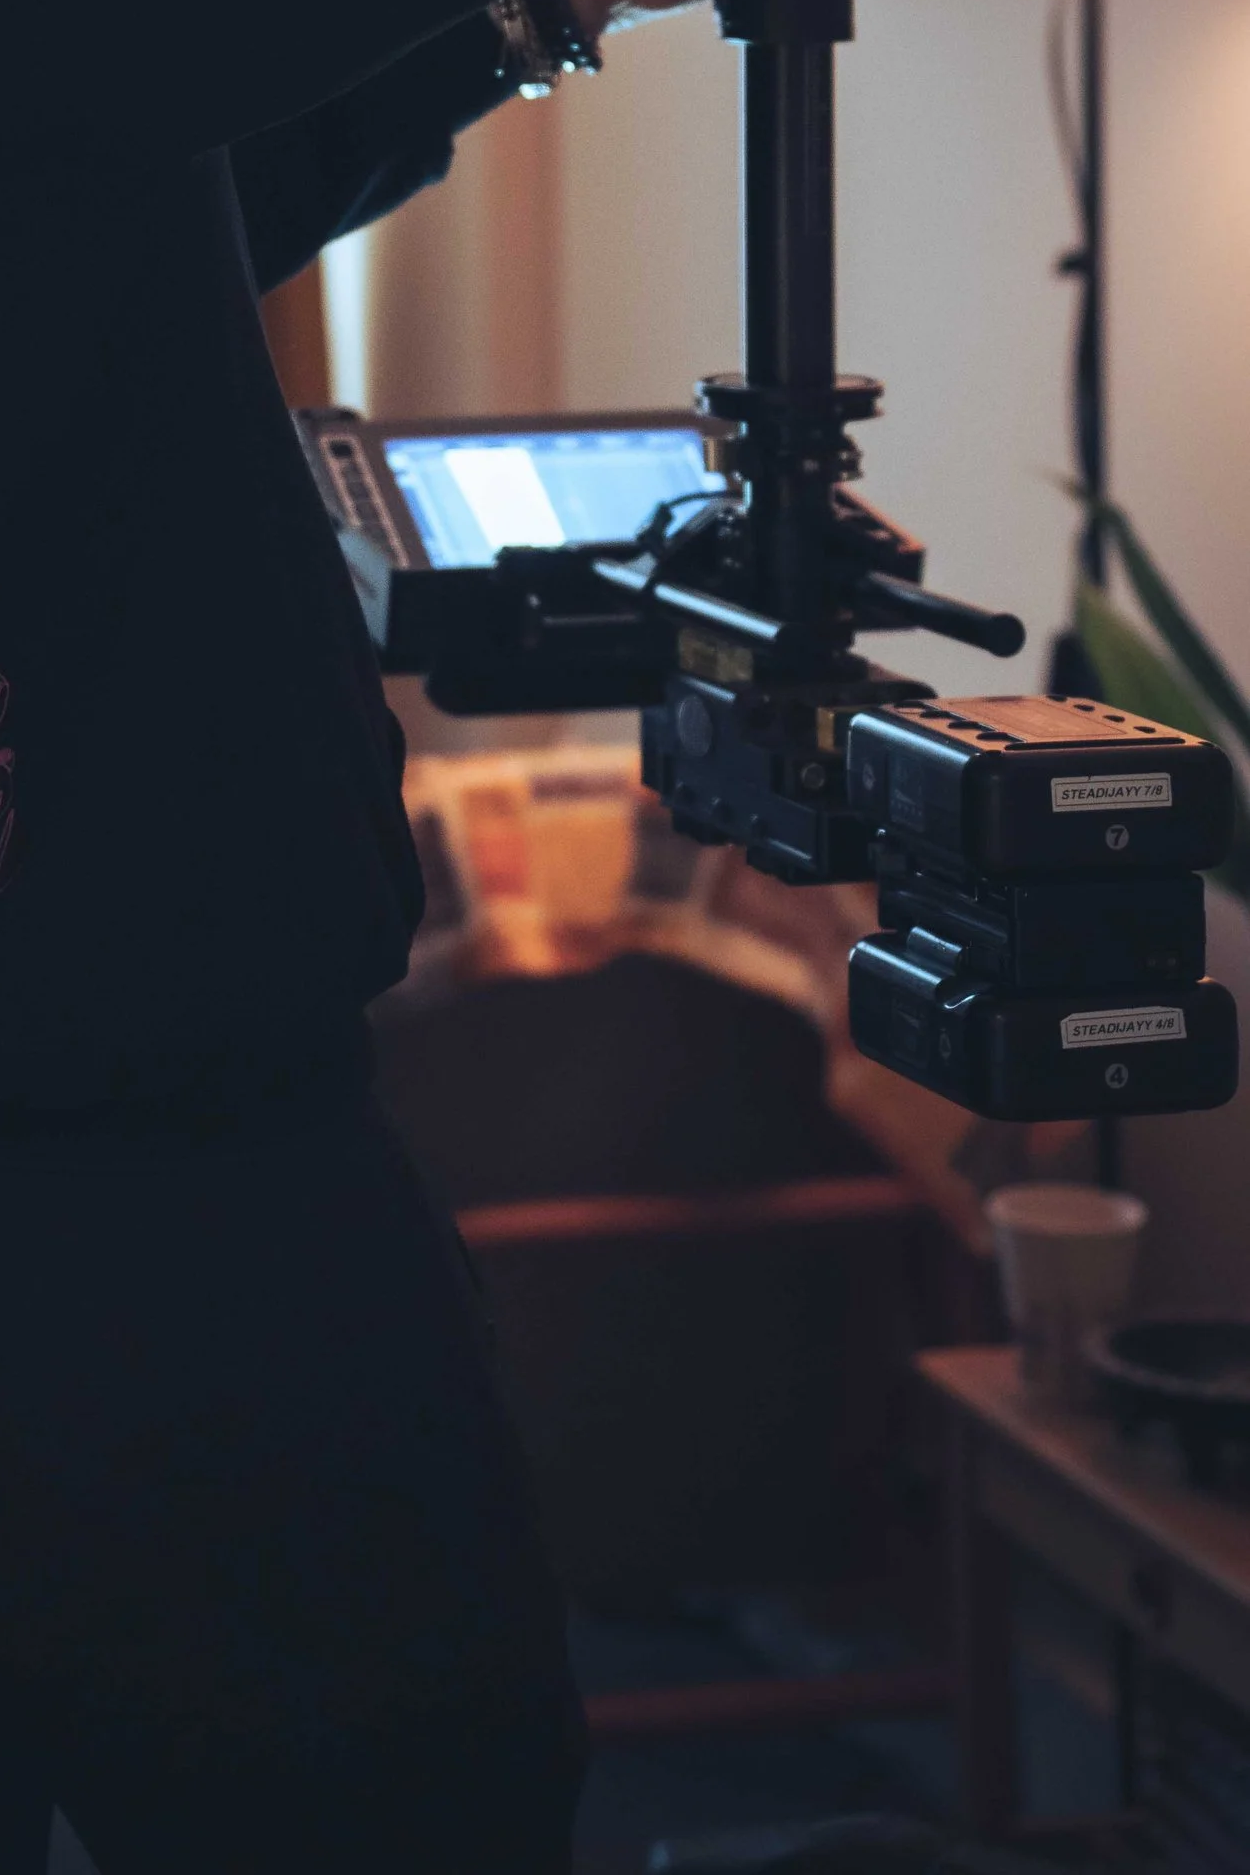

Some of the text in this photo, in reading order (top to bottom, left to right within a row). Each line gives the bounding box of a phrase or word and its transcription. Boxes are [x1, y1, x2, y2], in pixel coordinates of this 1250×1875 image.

[1061, 785, 1163, 800] STEADIJAYY 7/8
[1110, 828, 1124, 846] 7
[1072, 1017, 1174, 1036] STEADIJAYY 4/8
[1109, 1066, 1125, 1085] 4
